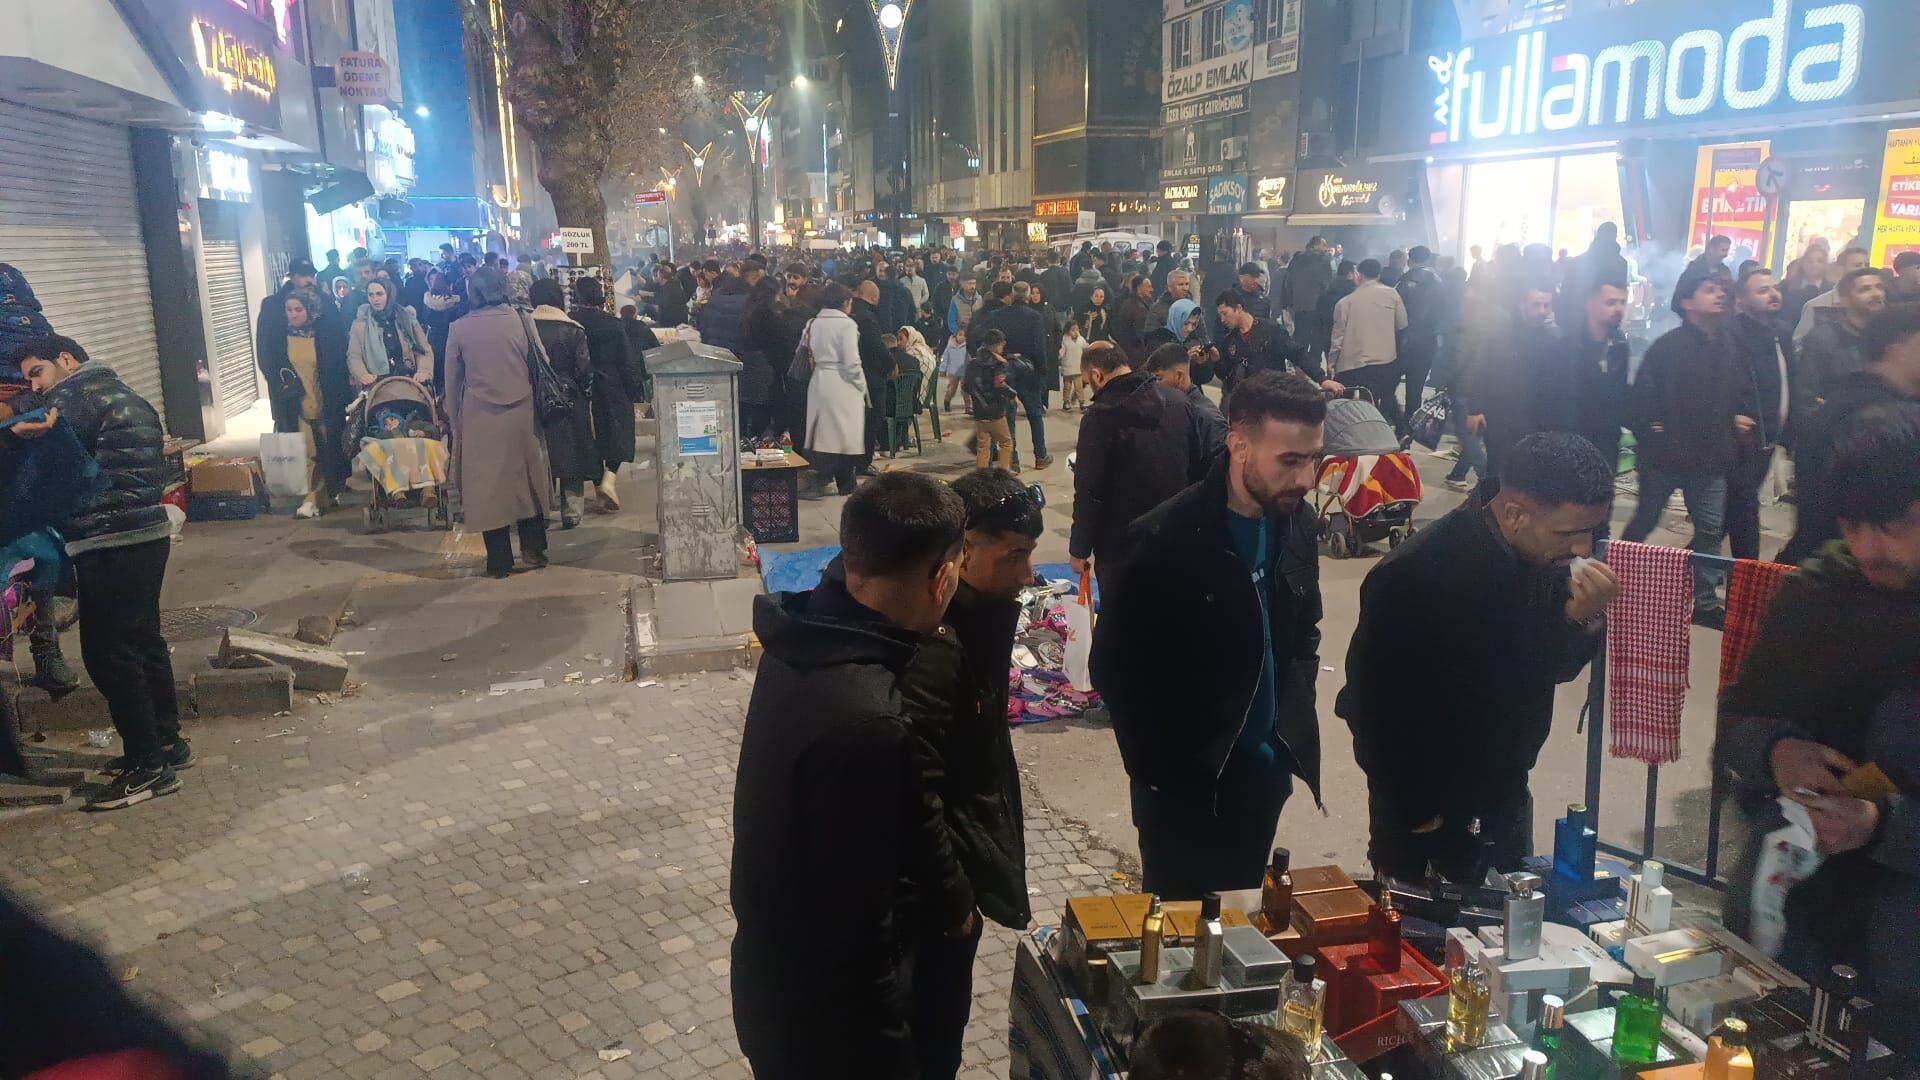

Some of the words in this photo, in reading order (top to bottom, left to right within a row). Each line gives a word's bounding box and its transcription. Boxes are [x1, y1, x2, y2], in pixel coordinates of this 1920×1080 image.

[340, 57, 383, 68] FATURA
[1449, 0, 1863, 142] fullamoda
[1167, 73, 1203, 98] ÖZALP
[1206, 59, 1249, 89] EMLAK
[340, 87, 388, 97] NOKTASI
[1209, 180, 1245, 204] SADIKSOY
